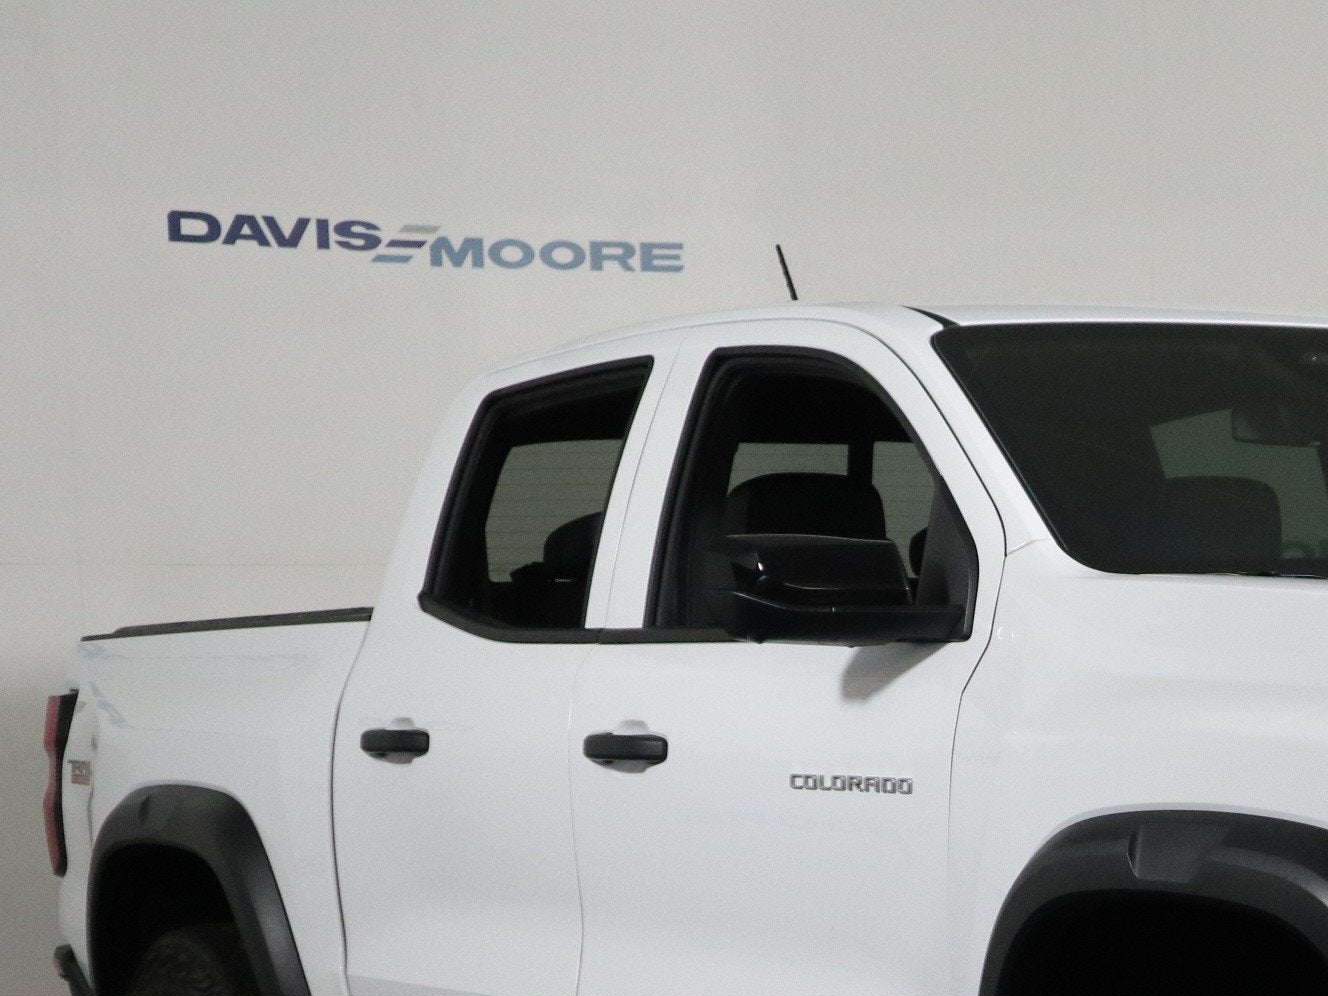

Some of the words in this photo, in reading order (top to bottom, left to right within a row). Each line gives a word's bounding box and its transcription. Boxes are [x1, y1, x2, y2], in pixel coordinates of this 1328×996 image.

[166, 209, 384, 251] DAVIS
[429, 236, 684, 273] MOORE
[789, 773, 913, 795] COLORADO
